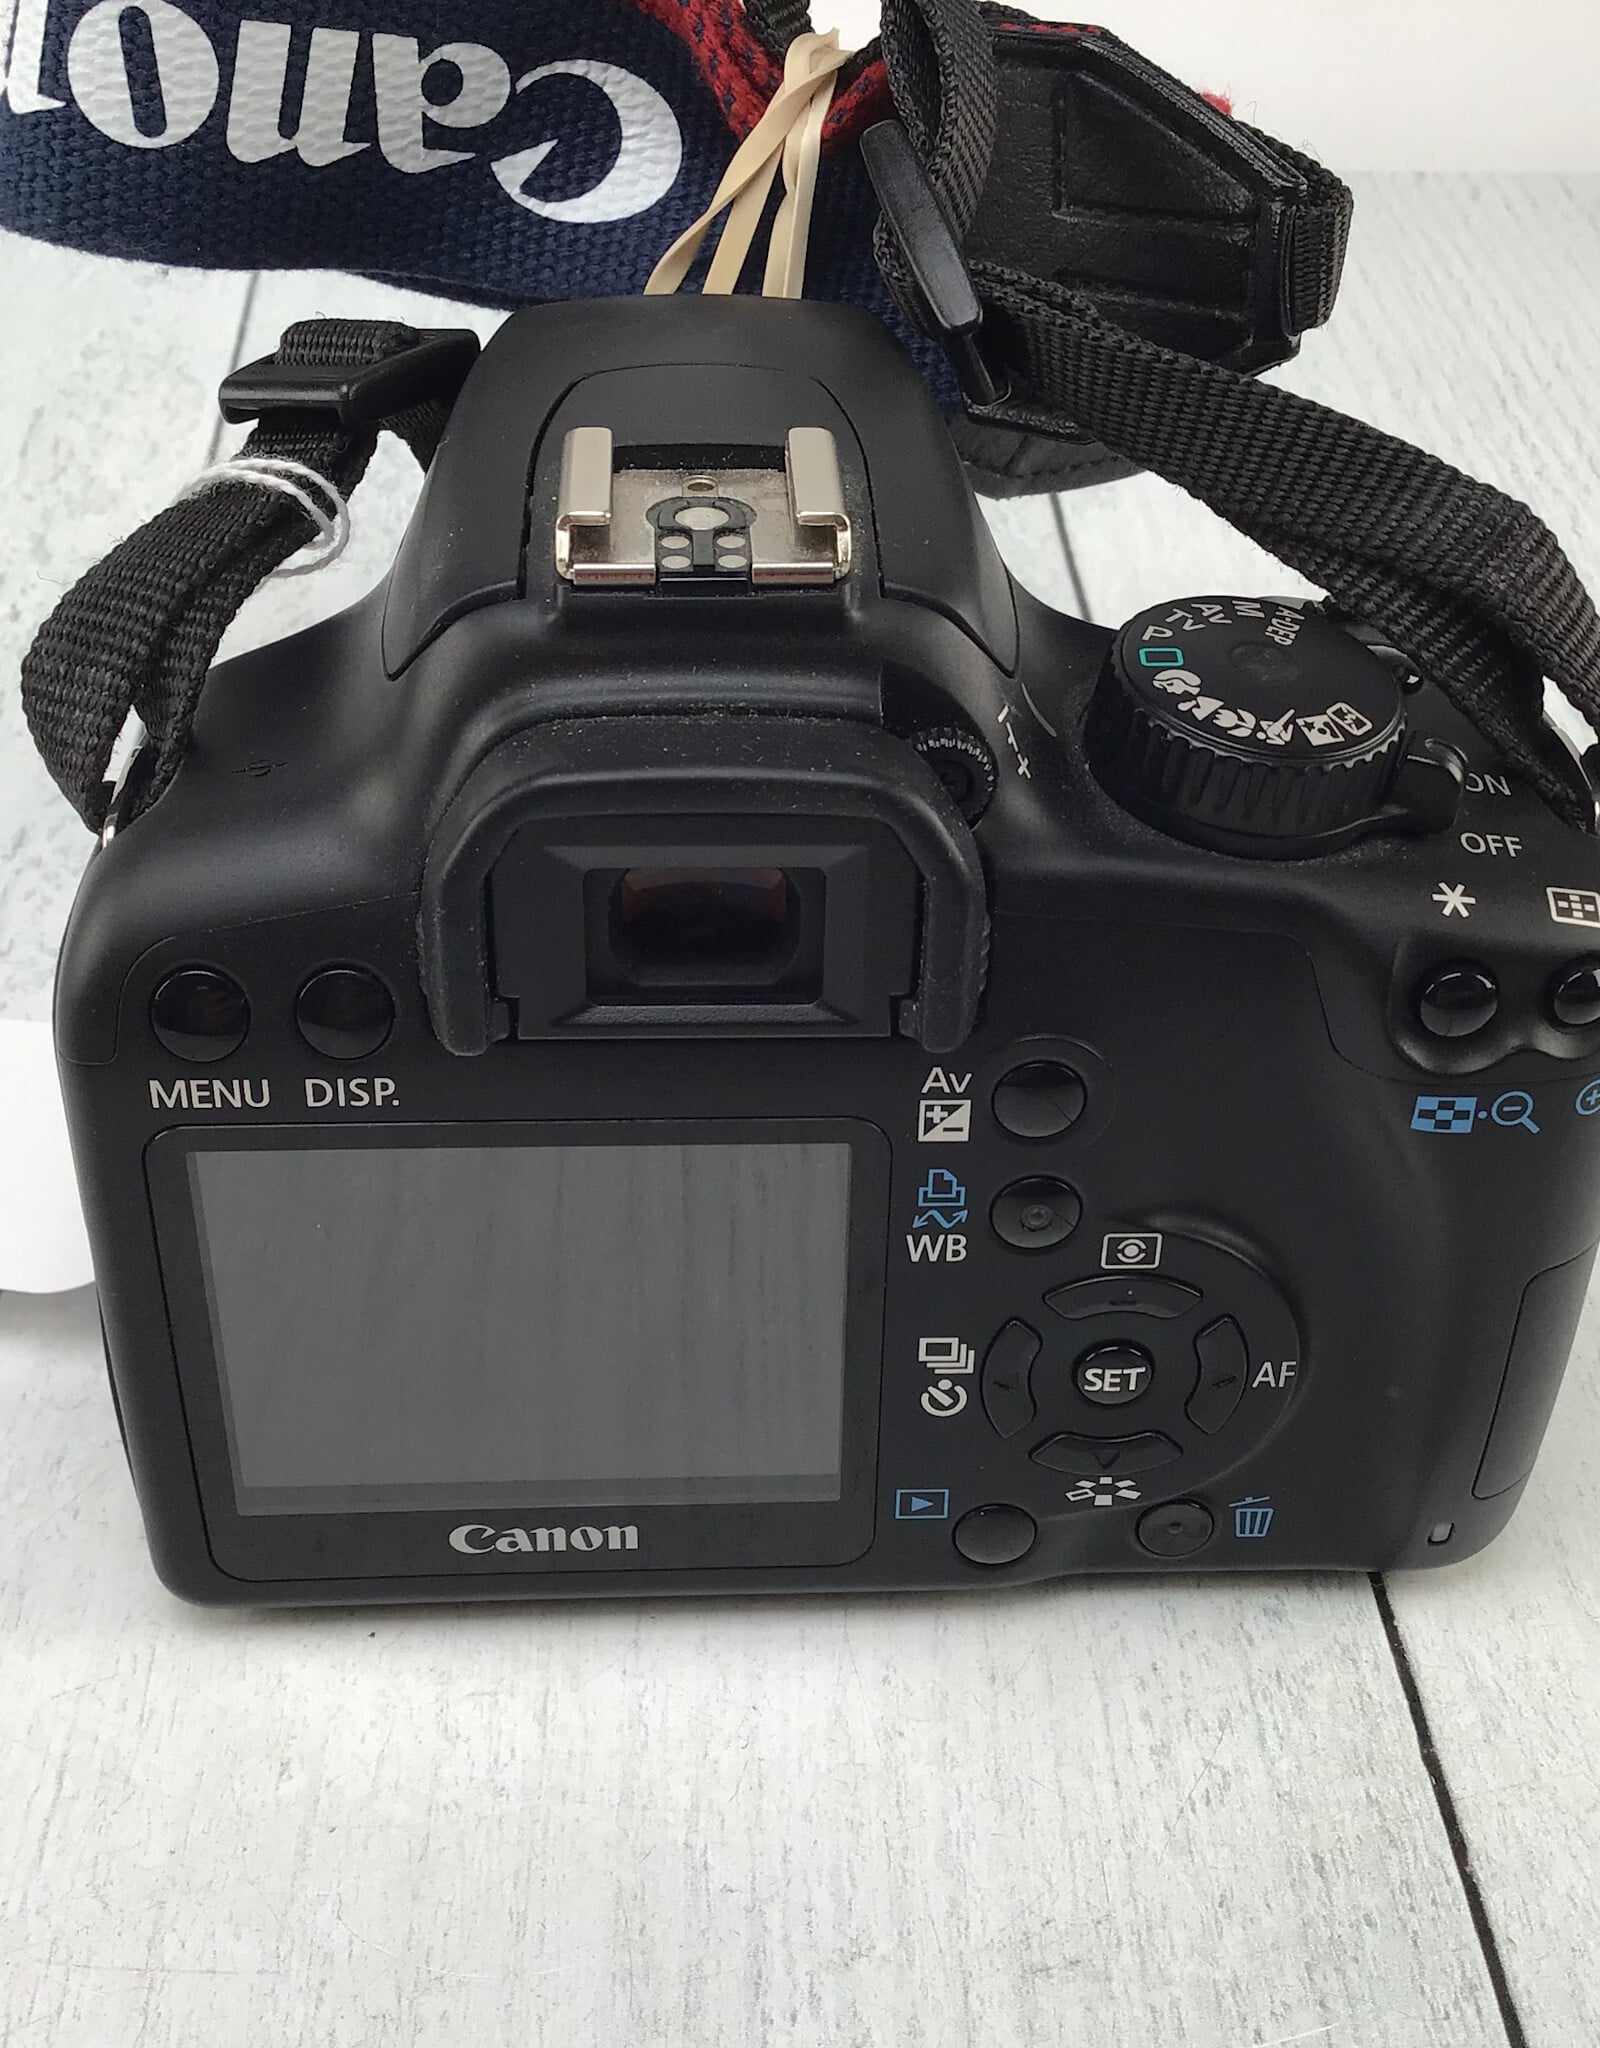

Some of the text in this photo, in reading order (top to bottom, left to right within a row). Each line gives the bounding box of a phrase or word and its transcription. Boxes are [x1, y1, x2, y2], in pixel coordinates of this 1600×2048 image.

[1164, 608, 1206, 632] Tv
[1232, 600, 1266, 620] M
[1142, 625, 1173, 641] P
[1465, 773, 1512, 796] ON
[1460, 832, 1522, 858] OFF
[149, 1078, 270, 1109] MENU
[304, 1077, 400, 1108] DISP.
[921, 1066, 973, 1094] Av
[906, 1234, 968, 1263] WB
[1083, 1367, 1146, 1392] SET
[1252, 1361, 1297, 1389] AF
[448, 1524, 639, 1555] Canon
